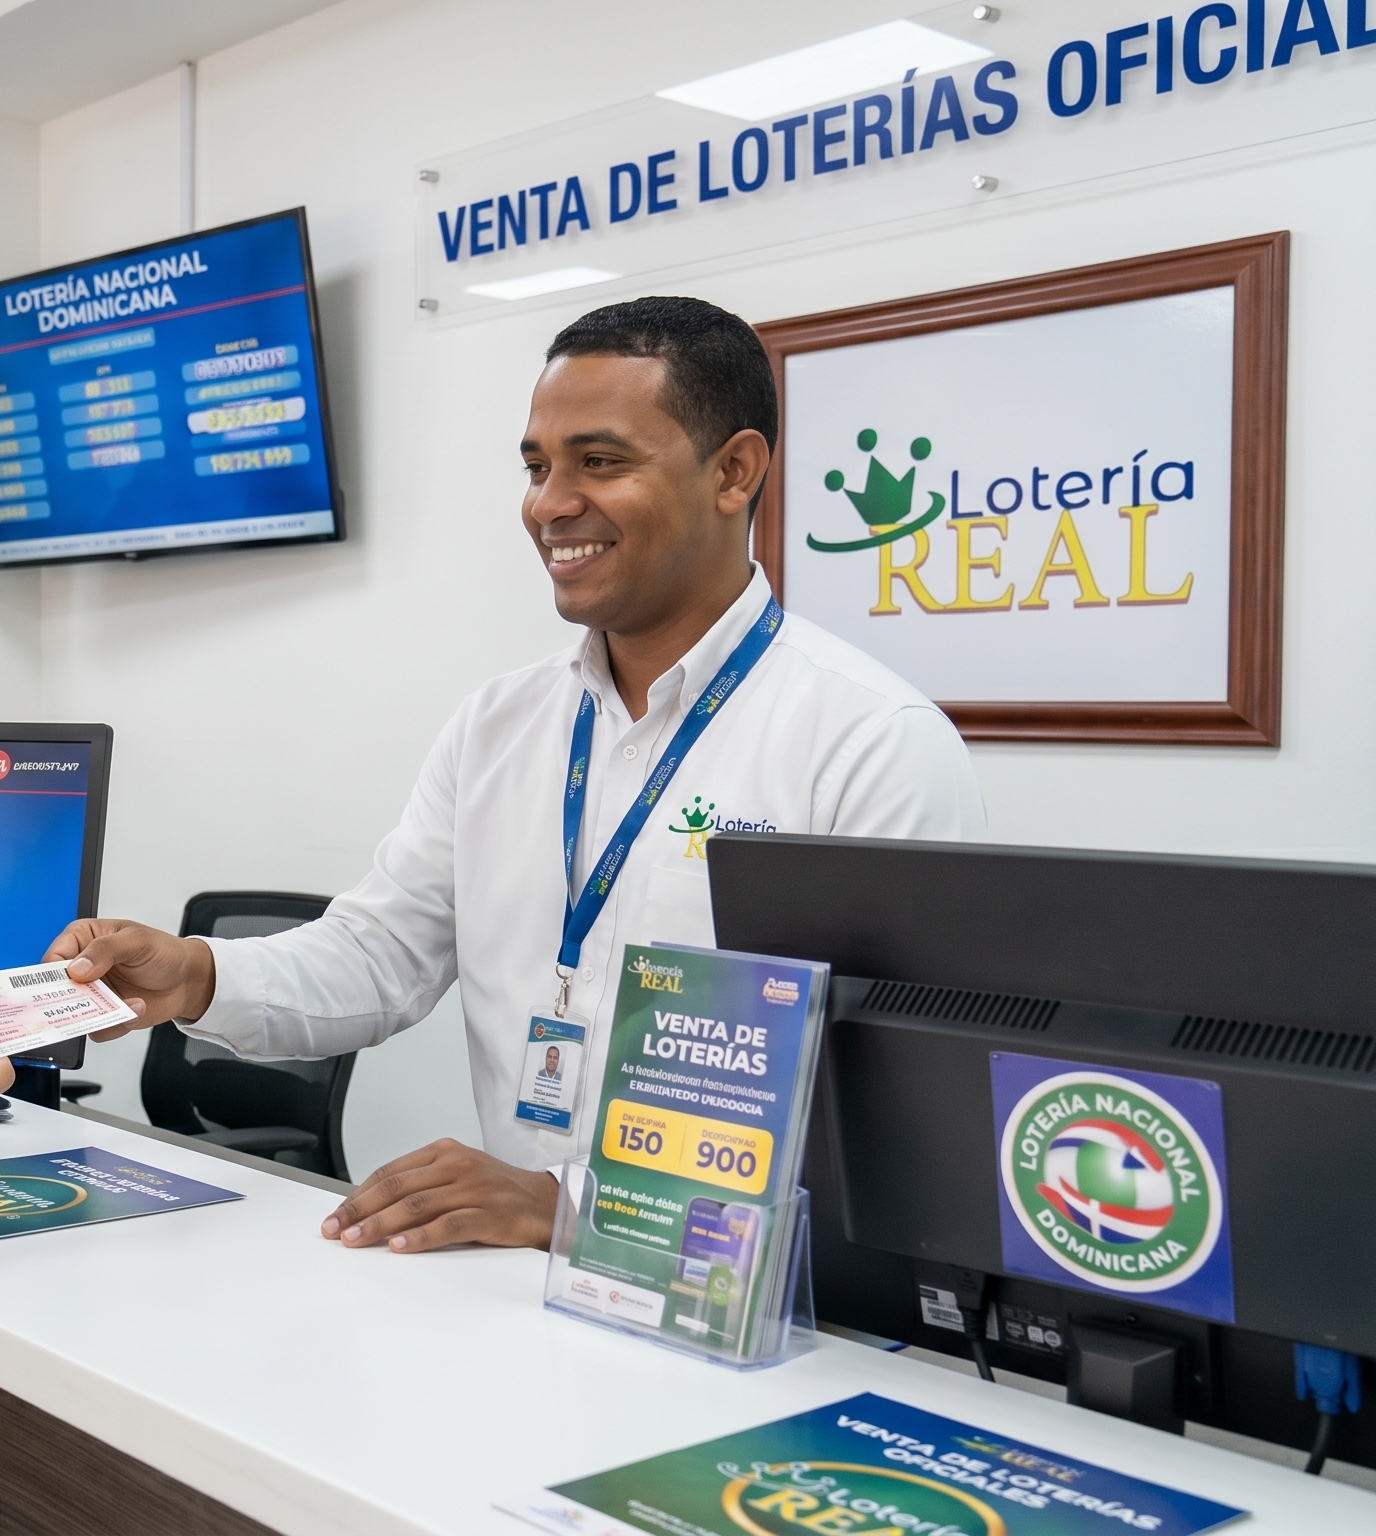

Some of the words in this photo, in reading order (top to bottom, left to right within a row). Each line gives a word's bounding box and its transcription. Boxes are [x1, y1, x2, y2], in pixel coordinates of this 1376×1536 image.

[438, 176, 590, 262] VENTA
[609, 150, 677, 224] DE
[698, 61, 1019, 203] LOTERÍAS
[5, 273, 91, 316] LOTERÍA
[93, 250, 208, 296] NACIONAL
[38, 283, 177, 333] DOMINICANA
[950, 448, 1195, 519] Lotería
[868, 503, 1195, 617] REAL
[640, 970, 684, 994] REAL
[642, 1033, 768, 1077] LOTERÍAS
[654, 1010, 728, 1042] VENTA
[734, 1025, 768, 1048] DE
[619, 1124, 663, 1156] 150
[696, 1141, 757, 1178] 900
[1019, 1091, 1091, 1171] LOTERÍA
[1095, 1092, 1201, 1203] NACIONAL
[1036, 1208, 1188, 1273] DOMINICANA
[836, 1414, 936, 1458] VENTA
[938, 1451, 992, 1474] DE
[882, 1447, 1050, 1509] OFICIALES
